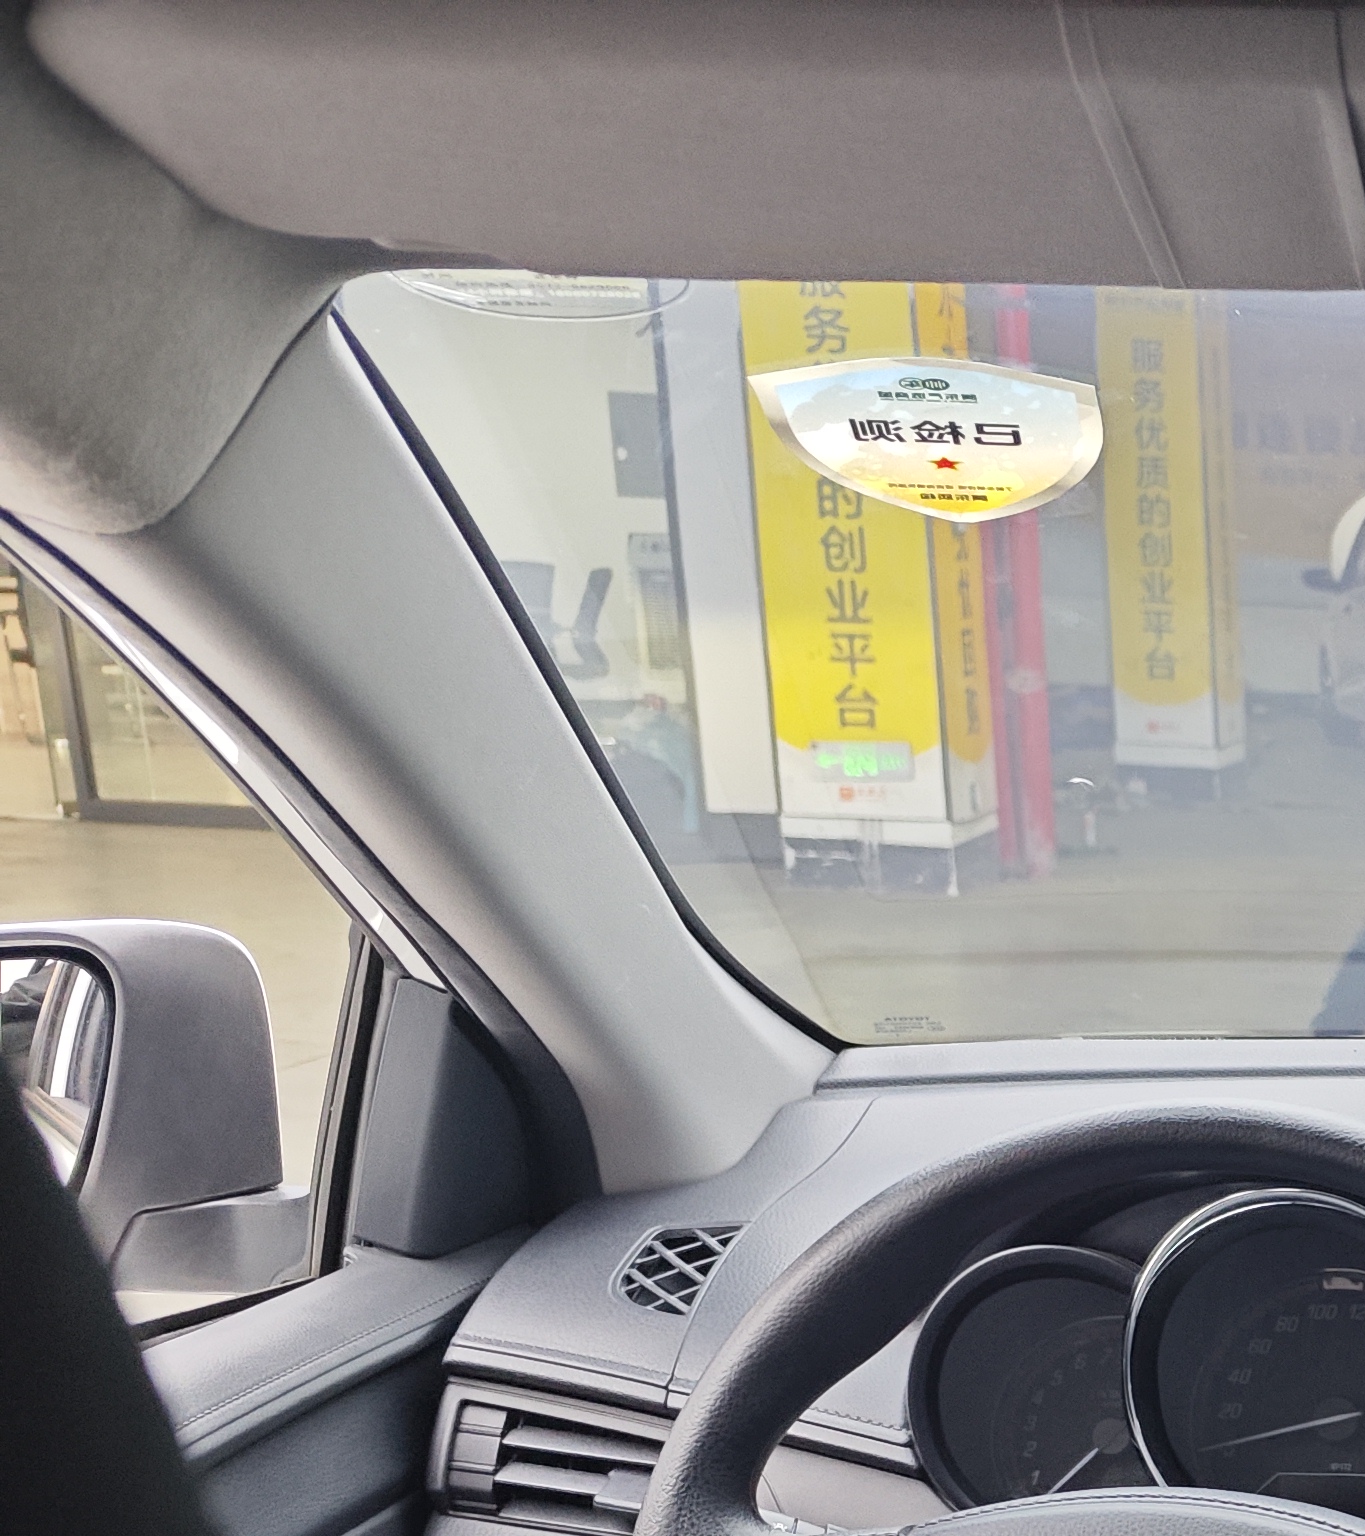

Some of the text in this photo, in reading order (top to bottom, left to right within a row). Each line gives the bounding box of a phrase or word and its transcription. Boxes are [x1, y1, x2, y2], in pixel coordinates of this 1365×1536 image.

[1130, 338, 1178, 682] 服务优质的创业平台
[1308, 1304, 1337, 1320] 100
[1276, 1316, 1299, 1332] 80
